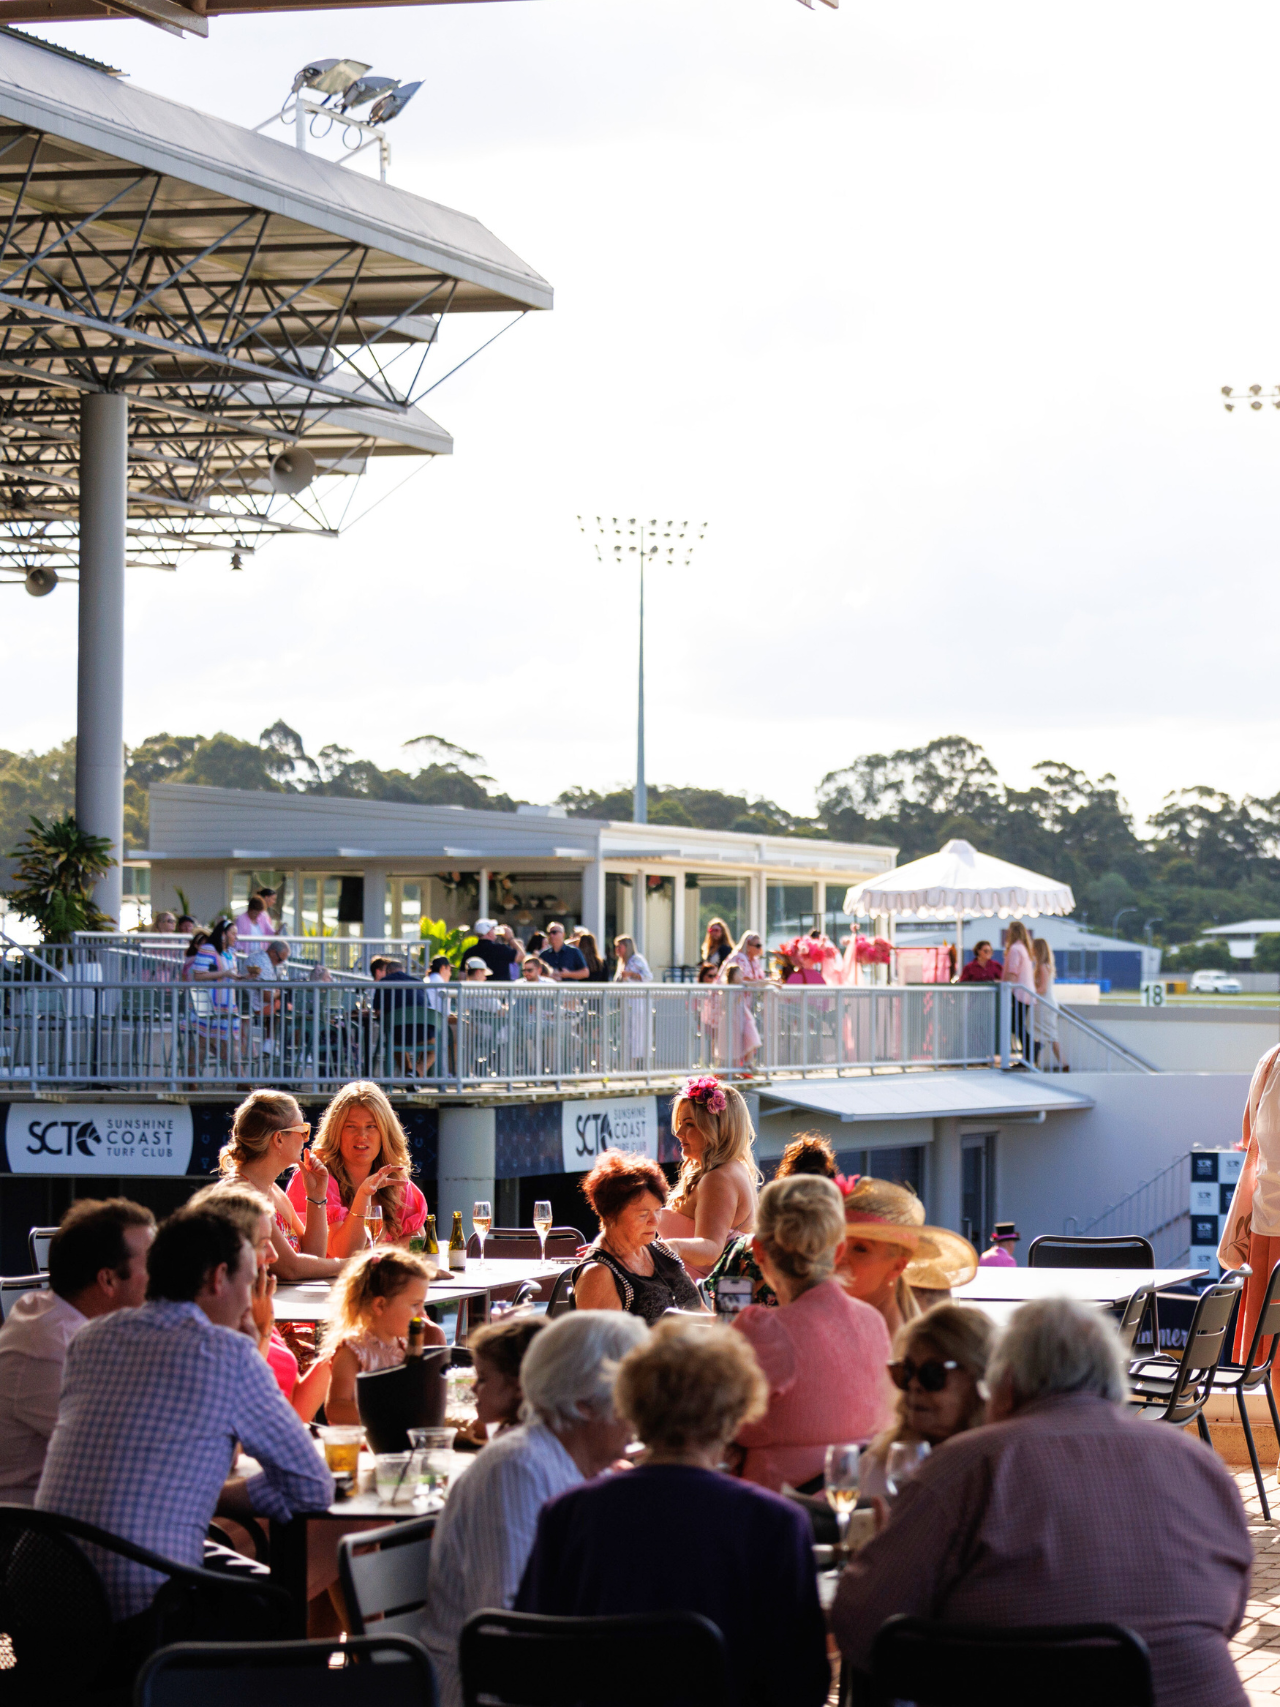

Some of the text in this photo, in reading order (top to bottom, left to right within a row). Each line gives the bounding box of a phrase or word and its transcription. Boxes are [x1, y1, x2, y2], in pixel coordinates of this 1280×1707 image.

[1144, 984, 1163, 1006] 18
[614, 1106, 646, 1120] SUNSHINE
[106, 1119, 174, 1130] SUNSHINE
[614, 1120, 646, 1140] COAST
[106, 1131, 174, 1146] COAST
[106, 1148, 173, 1157] TURF CLUB
[1136, 1327, 1189, 1347] mmer
